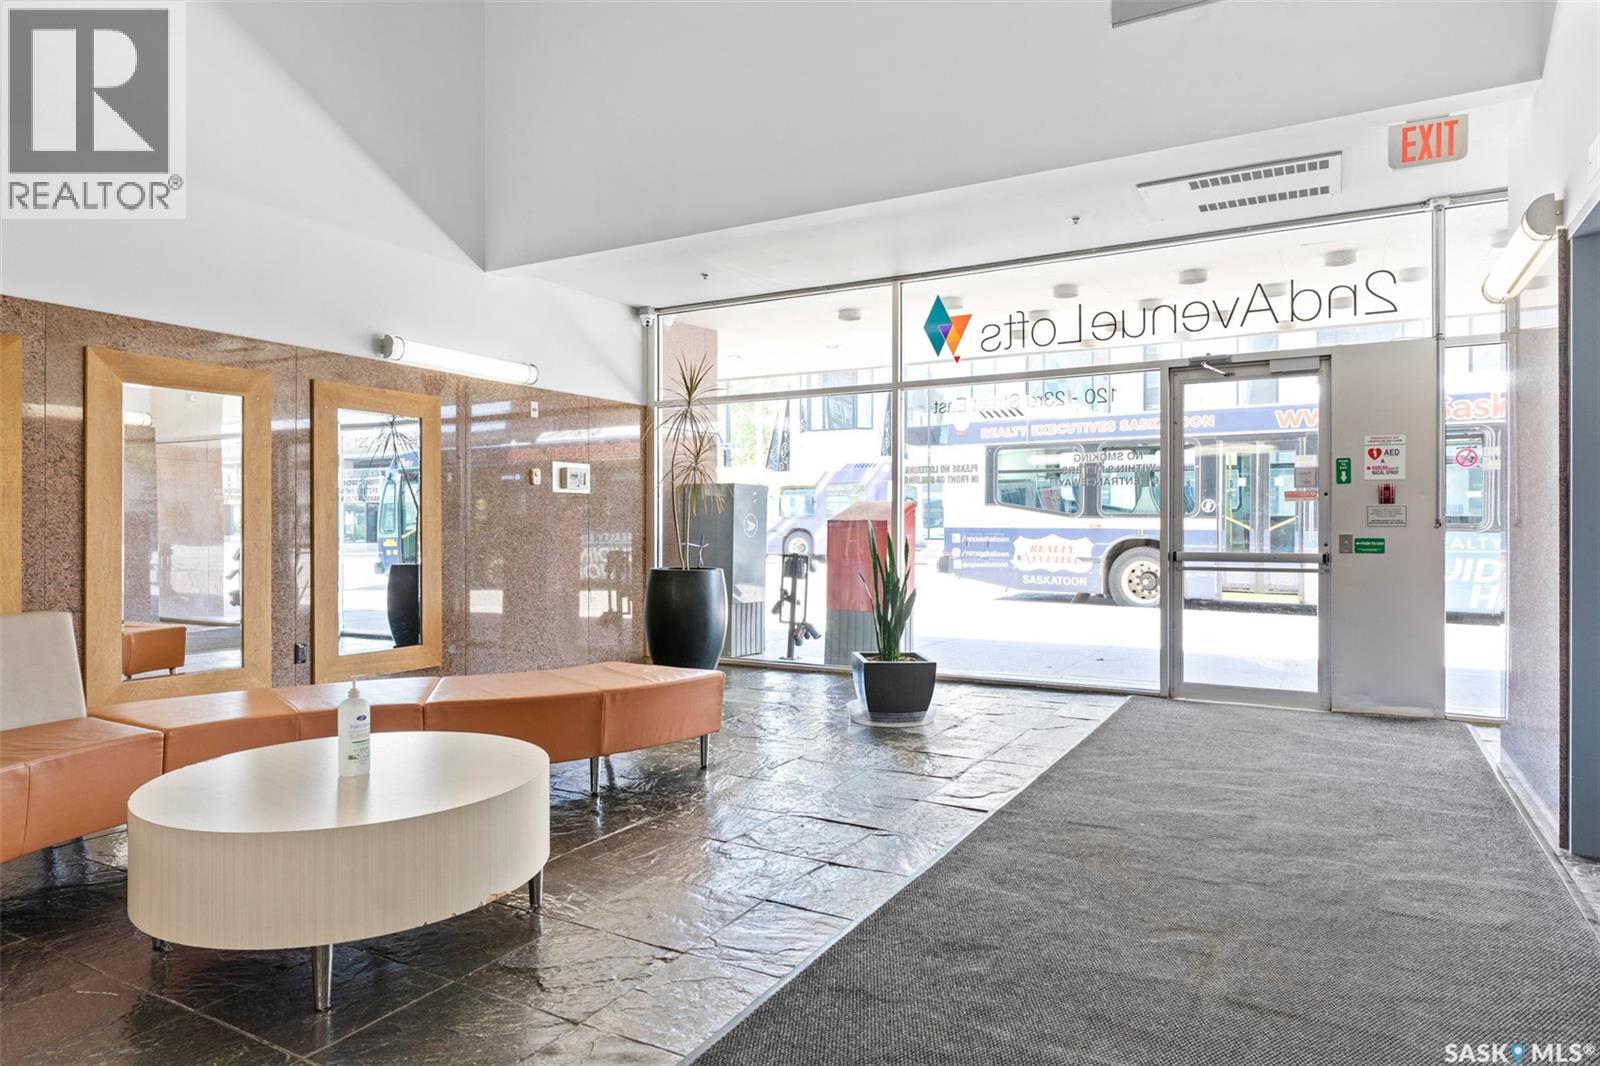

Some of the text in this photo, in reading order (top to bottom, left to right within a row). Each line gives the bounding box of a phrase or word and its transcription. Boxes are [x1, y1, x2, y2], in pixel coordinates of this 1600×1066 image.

[1401, 119, 1459, 163] EXIT
[980, 414, 1216, 440] REALTY EXECUTIVES SASKOON
[1384, 448, 1400, 456] AED
[1446, 536, 1502, 550] ALTY
[1022, 574, 1088, 587] SASKATOON
